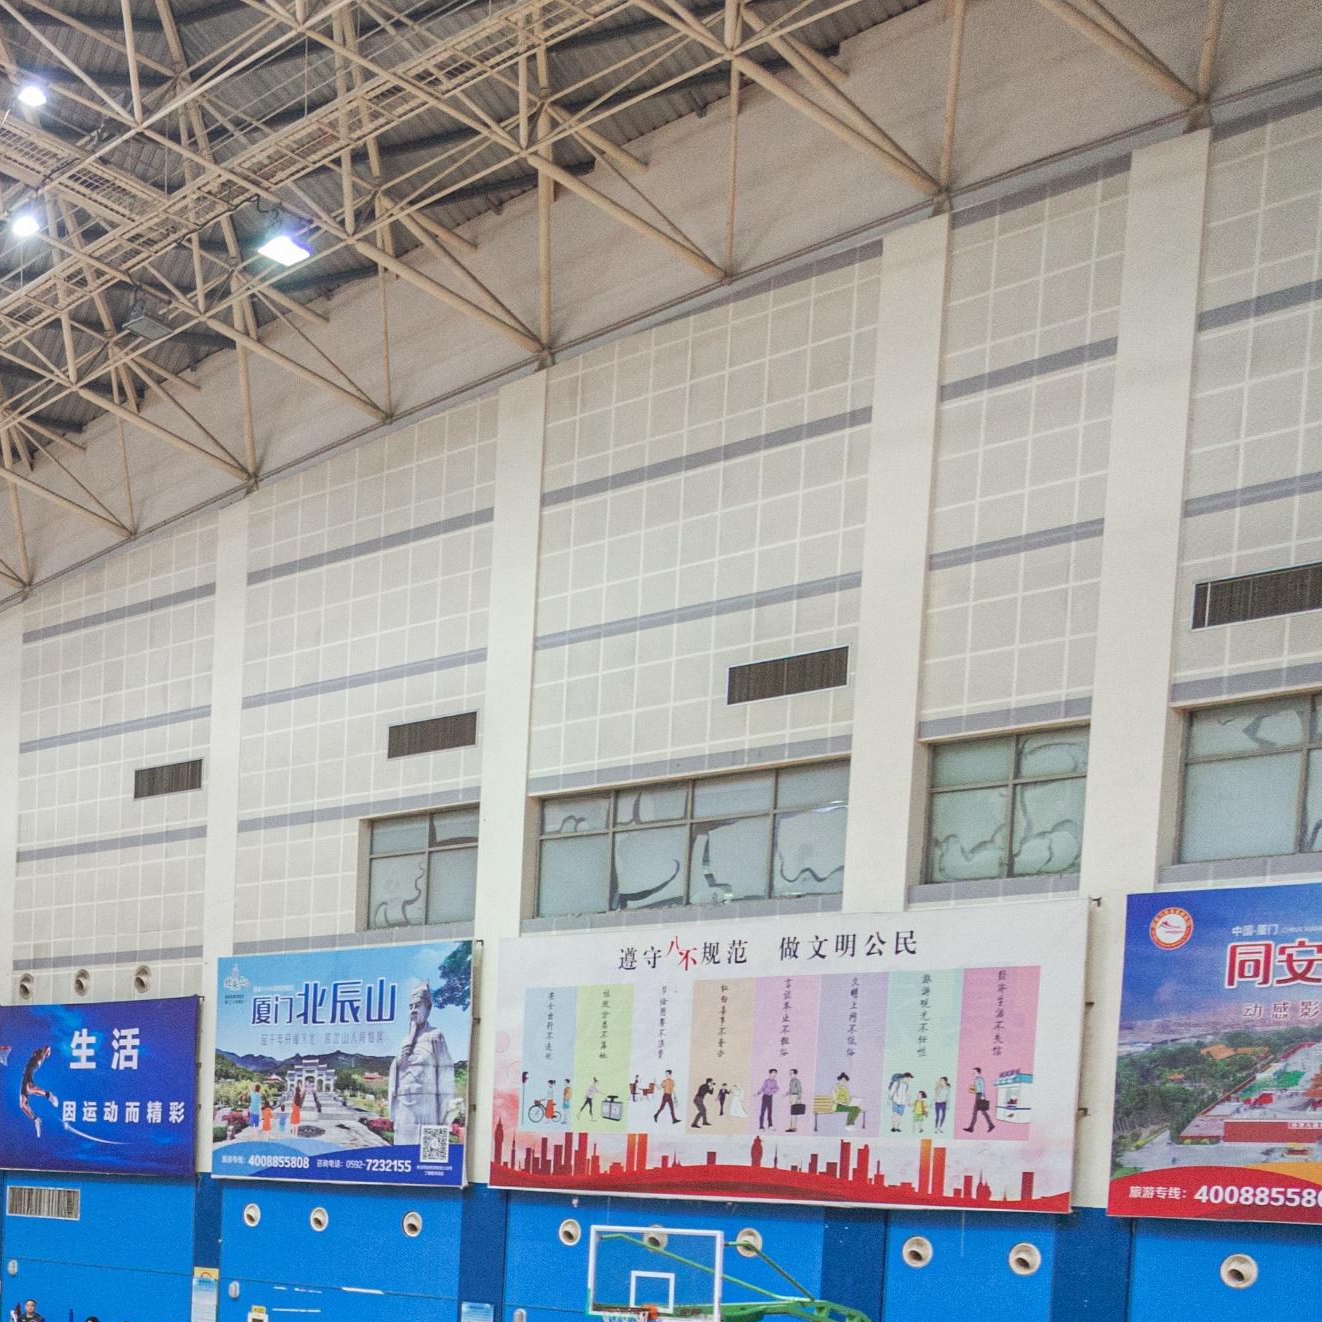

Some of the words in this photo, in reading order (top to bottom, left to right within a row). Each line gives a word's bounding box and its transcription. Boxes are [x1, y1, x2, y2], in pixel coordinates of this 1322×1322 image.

[618, 935, 749, 971] 遵守八不规范
[779, 930, 917, 962] 做文明公民
[252, 977, 397, 1025] 厦门北辰山
[69, 1027, 140, 1070] 生活
[62, 1100, 185, 1123] 因运动而精彩
[248, 1154, 310, 1169] 4008855808
[345, 1158, 412, 1173] 0592-7232155
[1129, 1185, 1186, 1199] 旅游专线：
[1193, 1184, 1322, 1208] 40088558
